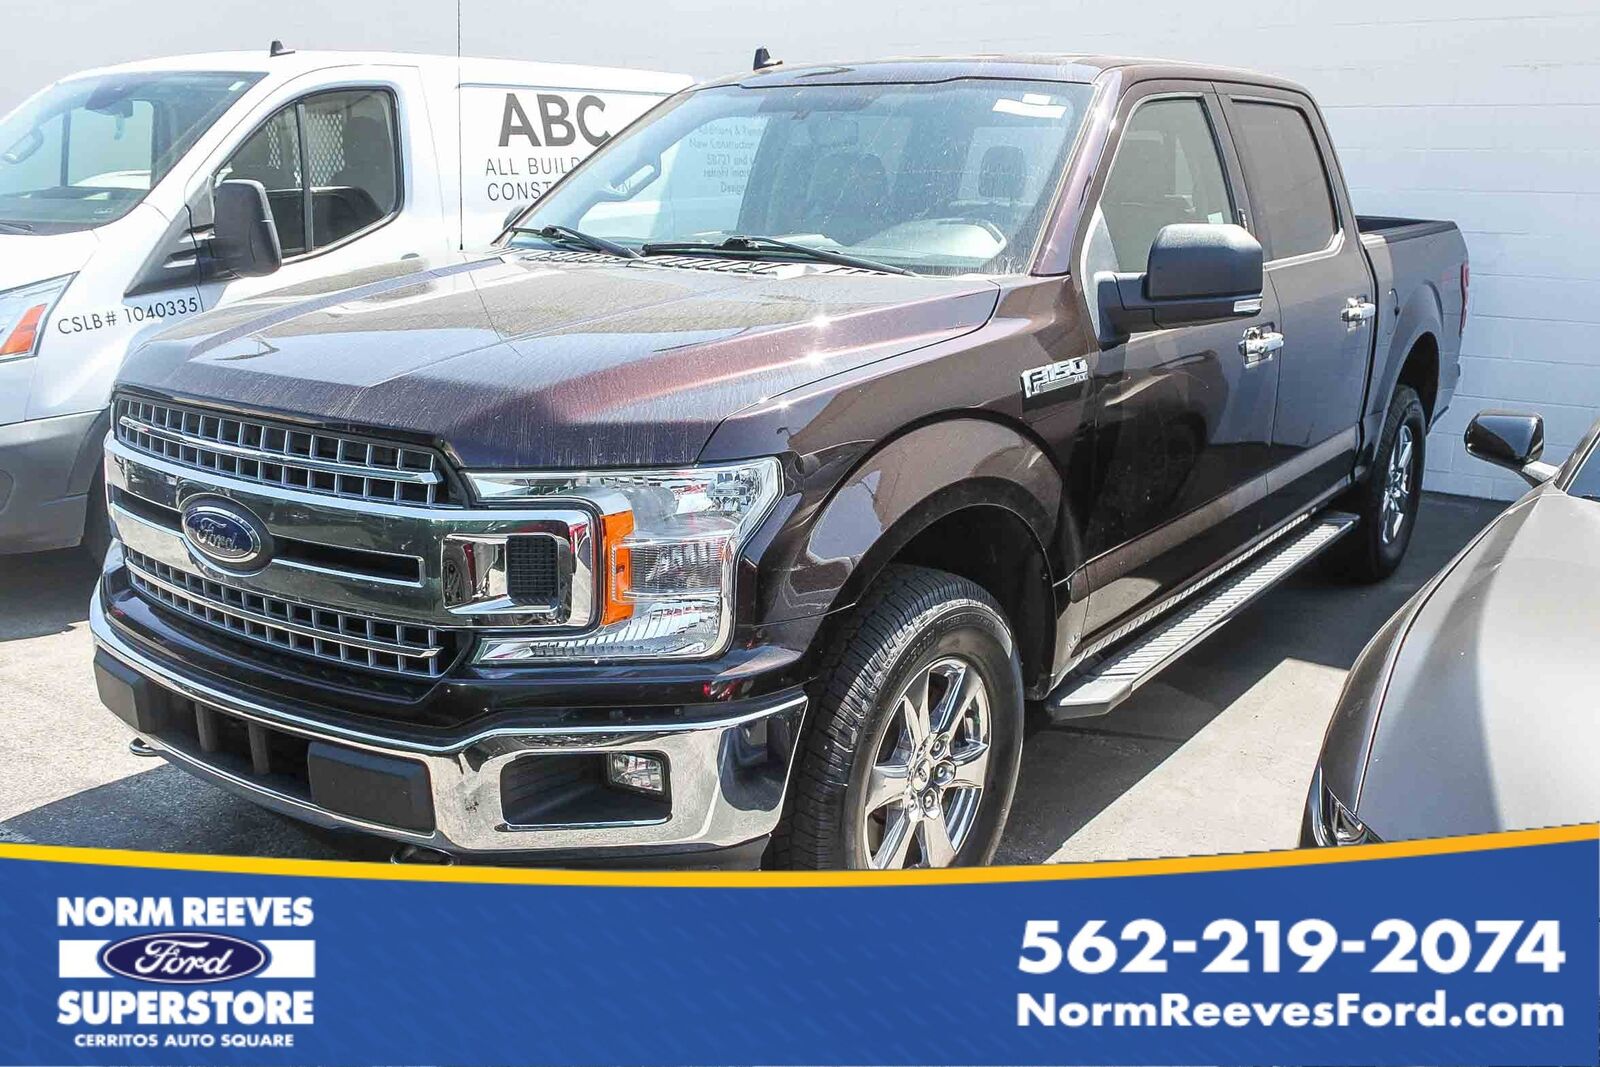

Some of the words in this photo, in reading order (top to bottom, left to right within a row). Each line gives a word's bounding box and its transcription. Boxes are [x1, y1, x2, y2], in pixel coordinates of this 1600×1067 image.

[498, 93, 611, 147] ABC
[485, 157, 520, 176] ALL
[124, 297, 198, 323] 1040335
[196, 517, 238, 552] Ford
